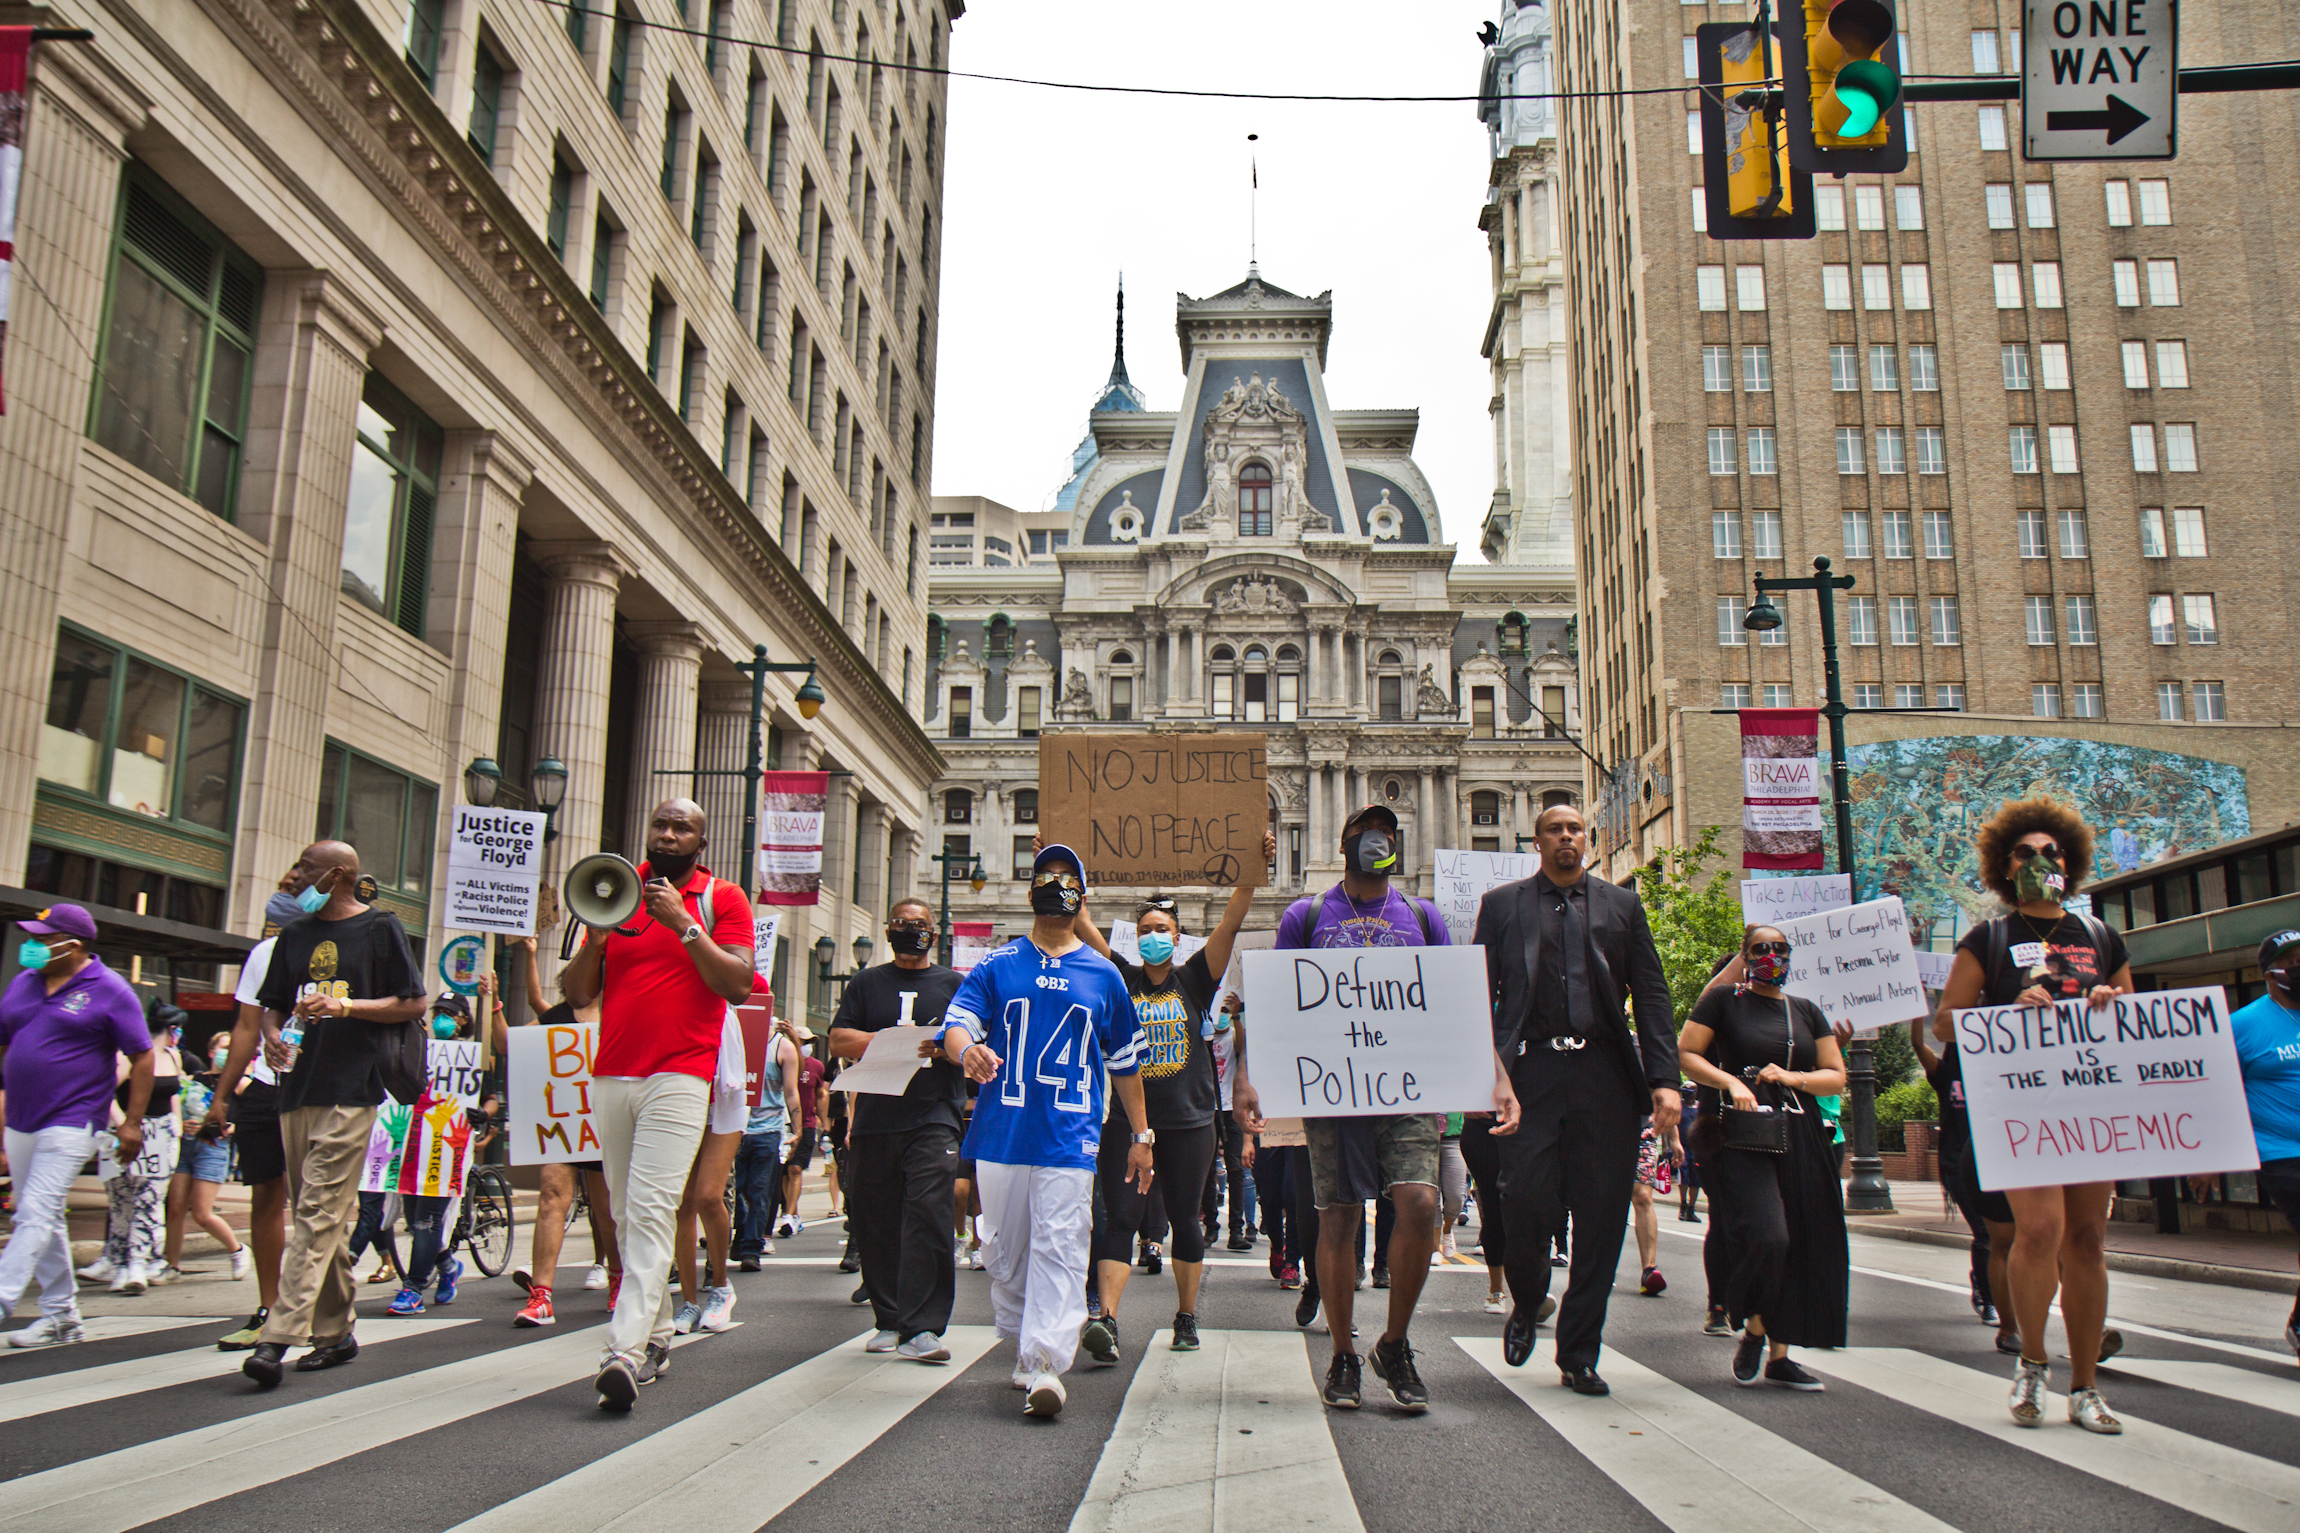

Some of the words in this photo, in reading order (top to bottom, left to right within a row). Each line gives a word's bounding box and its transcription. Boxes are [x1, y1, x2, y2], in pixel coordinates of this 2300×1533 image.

[2053, 0, 2148, 38] ONE
[2051, 45, 2151, 86] WAY
[1067, 749, 1134, 793] NO
[1140, 748, 1268, 784] JUSTICE
[1749, 763, 1810, 783] BRAVA
[457, 812, 534, 836] Justice
[768, 815, 817, 833] BRAVA
[1091, 814, 1143, 859] NO
[1151, 813, 1247, 859] PEACE
[460, 835, 472, 843] for
[473, 832, 534, 853] George
[481, 848, 526, 868] Floyd
[1436, 852, 1469, 876] WE
[461, 890, 494, 902] Racist
[496, 894, 529, 906] Police
[467, 879, 487, 890] ALL
[489, 881, 530, 894] Victims
[1453, 881, 1474, 893] NOT
[1743, 883, 1784, 904] Take
[478, 903, 528, 918] Violence!
[1453, 898, 1479, 911] NOT
[755, 920, 774, 933] ice
[1114, 926, 1136, 942] What
[1342, 916, 1365, 926] Omega
[1366, 915, 1379, 924] Psi
[1379, 918, 1391, 928] Phi
[1441, 913, 1477, 929] Black
[1826, 915, 1844, 940] for
[1848, 913, 1880, 938] George
[1877, 908, 1903, 931] Floyd
[755, 931, 773, 943] rge
[1816, 955, 1831, 976] for
[1872, 947, 1901, 968] Taylor
[1294, 954, 1427, 1011] Defund
[1819, 995, 1835, 1014] for
[1842, 984, 1883, 1011] Ahmaud
[1887, 981, 1918, 1003] Arbery
[1344, 1021, 1388, 1048] the
[1960, 1001, 2106, 1055] SYSTEMIC
[2114, 995, 2219, 1043] RACISM
[547, 1026, 594, 1078] BL
[1000, 997, 1093, 1114] 14
[2076, 1048, 2100, 1067] IS
[427, 1065, 484, 1096] HTS
[1296, 1056, 1421, 1109] Police
[1999, 1070, 2047, 1089] THE
[2062, 1065, 2122, 1087] MORE
[2137, 1059, 2205, 1082] DEADLY
[544, 1080, 592, 1118] LI
[536, 1118, 600, 1155] MA
[2004, 1112, 2201, 1158] PANDEMIC
[370, 1156, 384, 1185] HOPE
[387, 1140, 403, 1191] LBERTY
